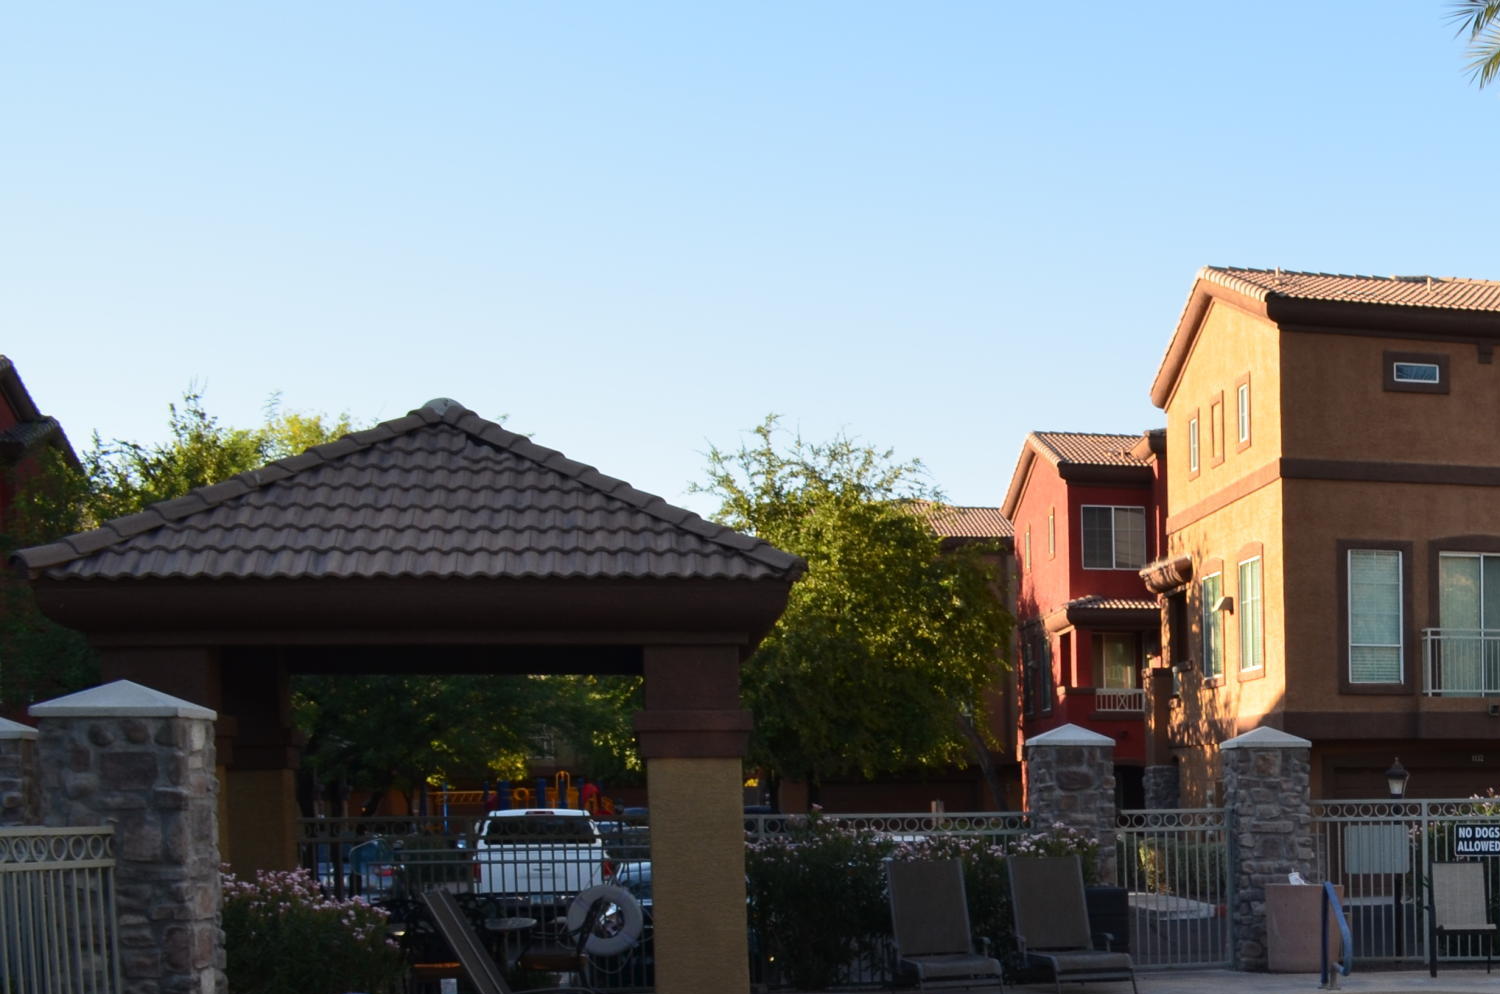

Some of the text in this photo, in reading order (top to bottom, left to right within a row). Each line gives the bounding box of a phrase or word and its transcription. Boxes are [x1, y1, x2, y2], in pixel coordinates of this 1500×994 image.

[1458, 827, 1500, 838] NO DOGS
[1457, 840, 1500, 852] ALLOWED
